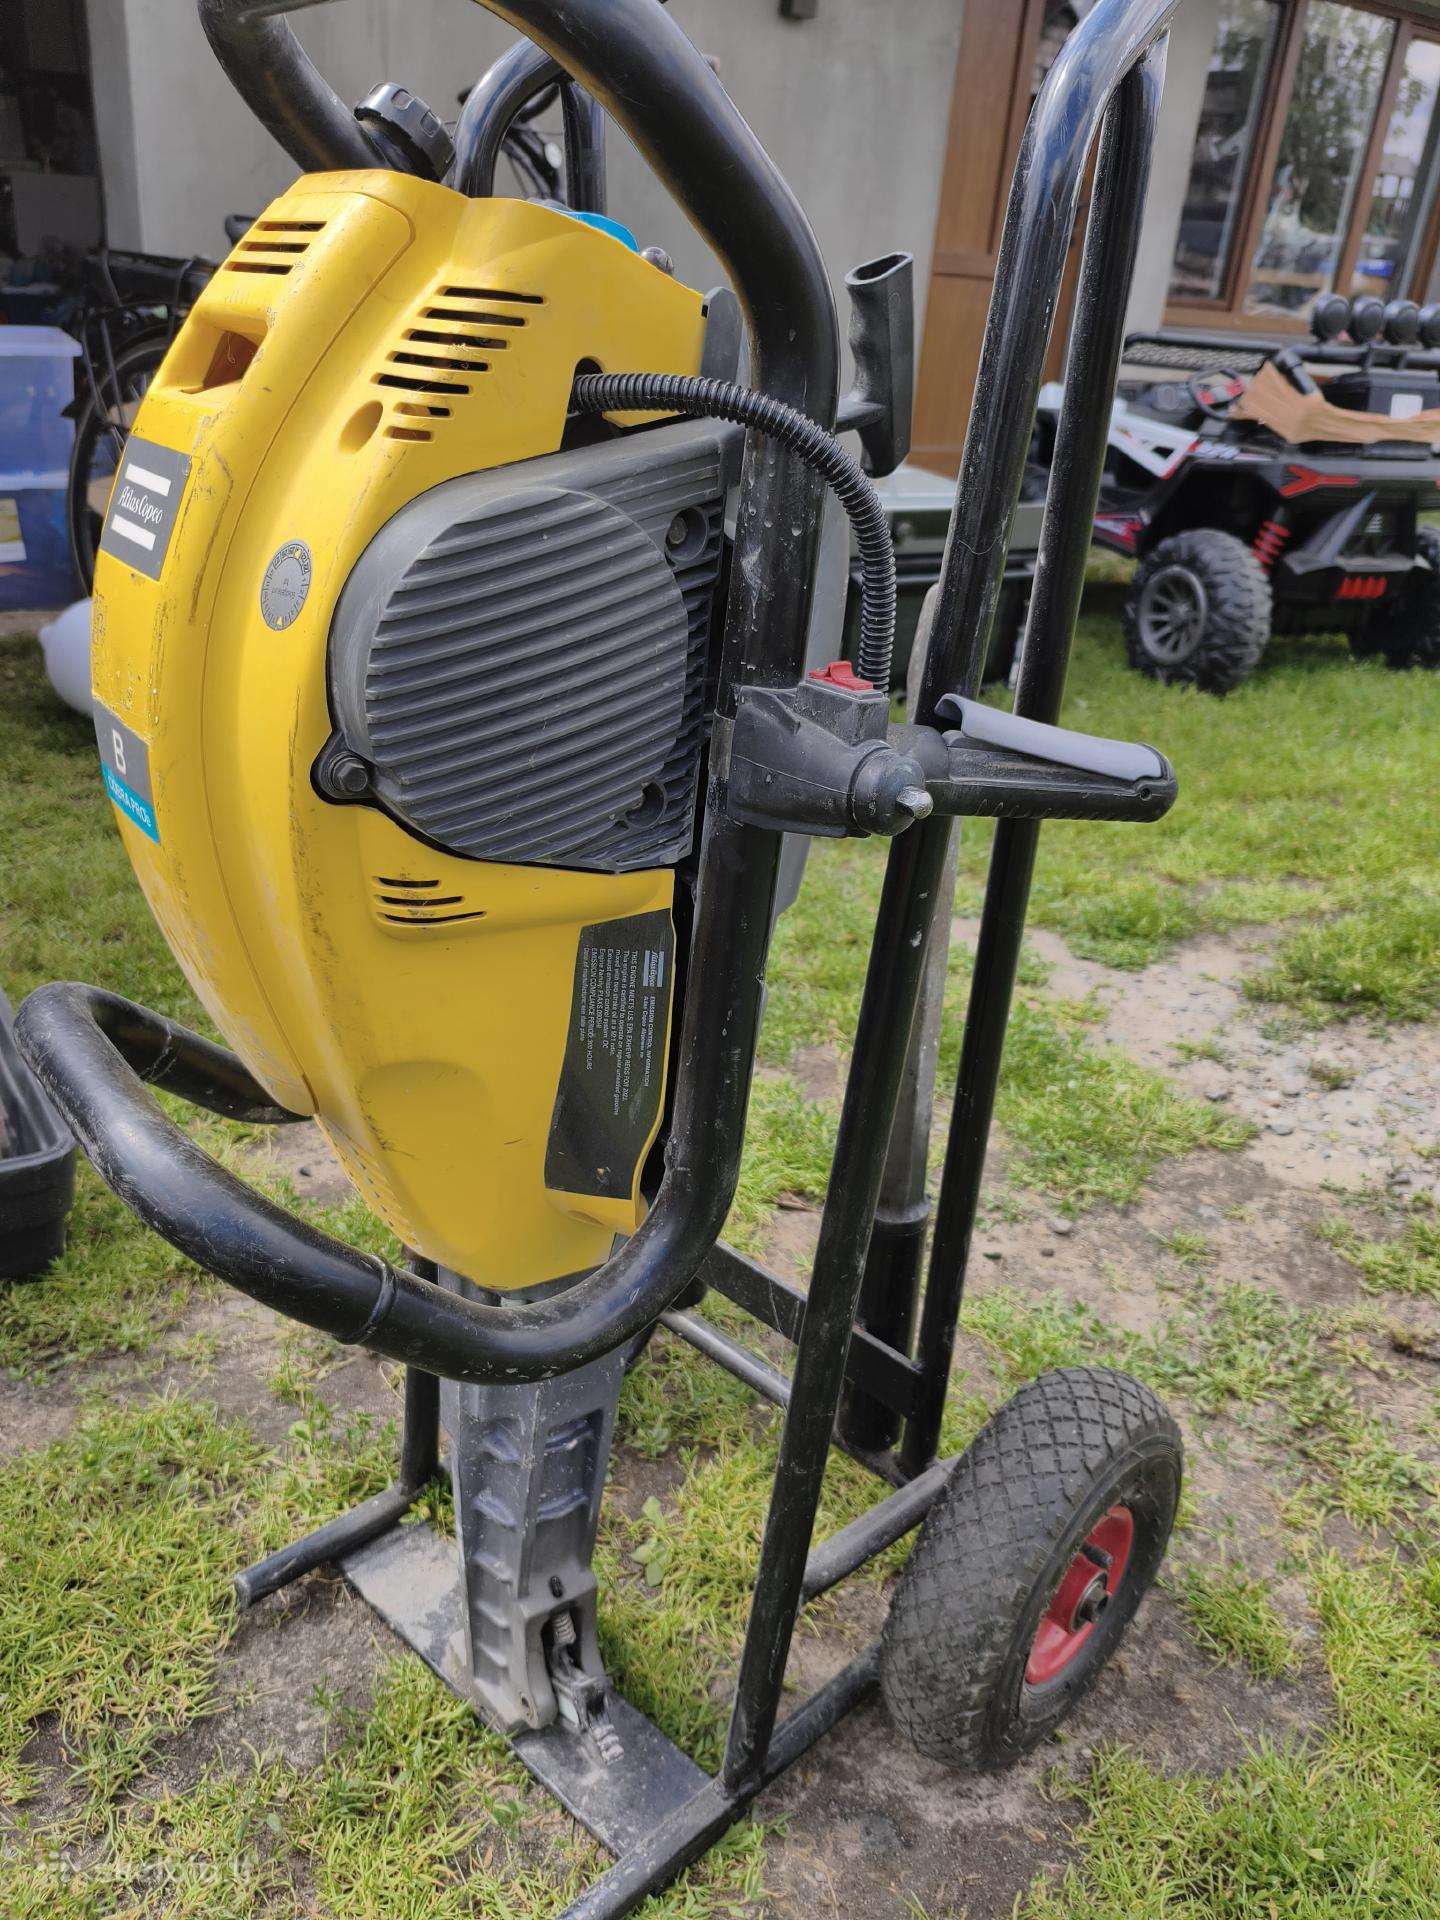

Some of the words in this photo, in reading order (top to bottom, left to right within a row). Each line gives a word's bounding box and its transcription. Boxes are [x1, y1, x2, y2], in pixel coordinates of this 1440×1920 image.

[118, 485, 140, 513] Atlas
[137, 494, 164, 524] Copco
[112, 728, 126, 775] B
